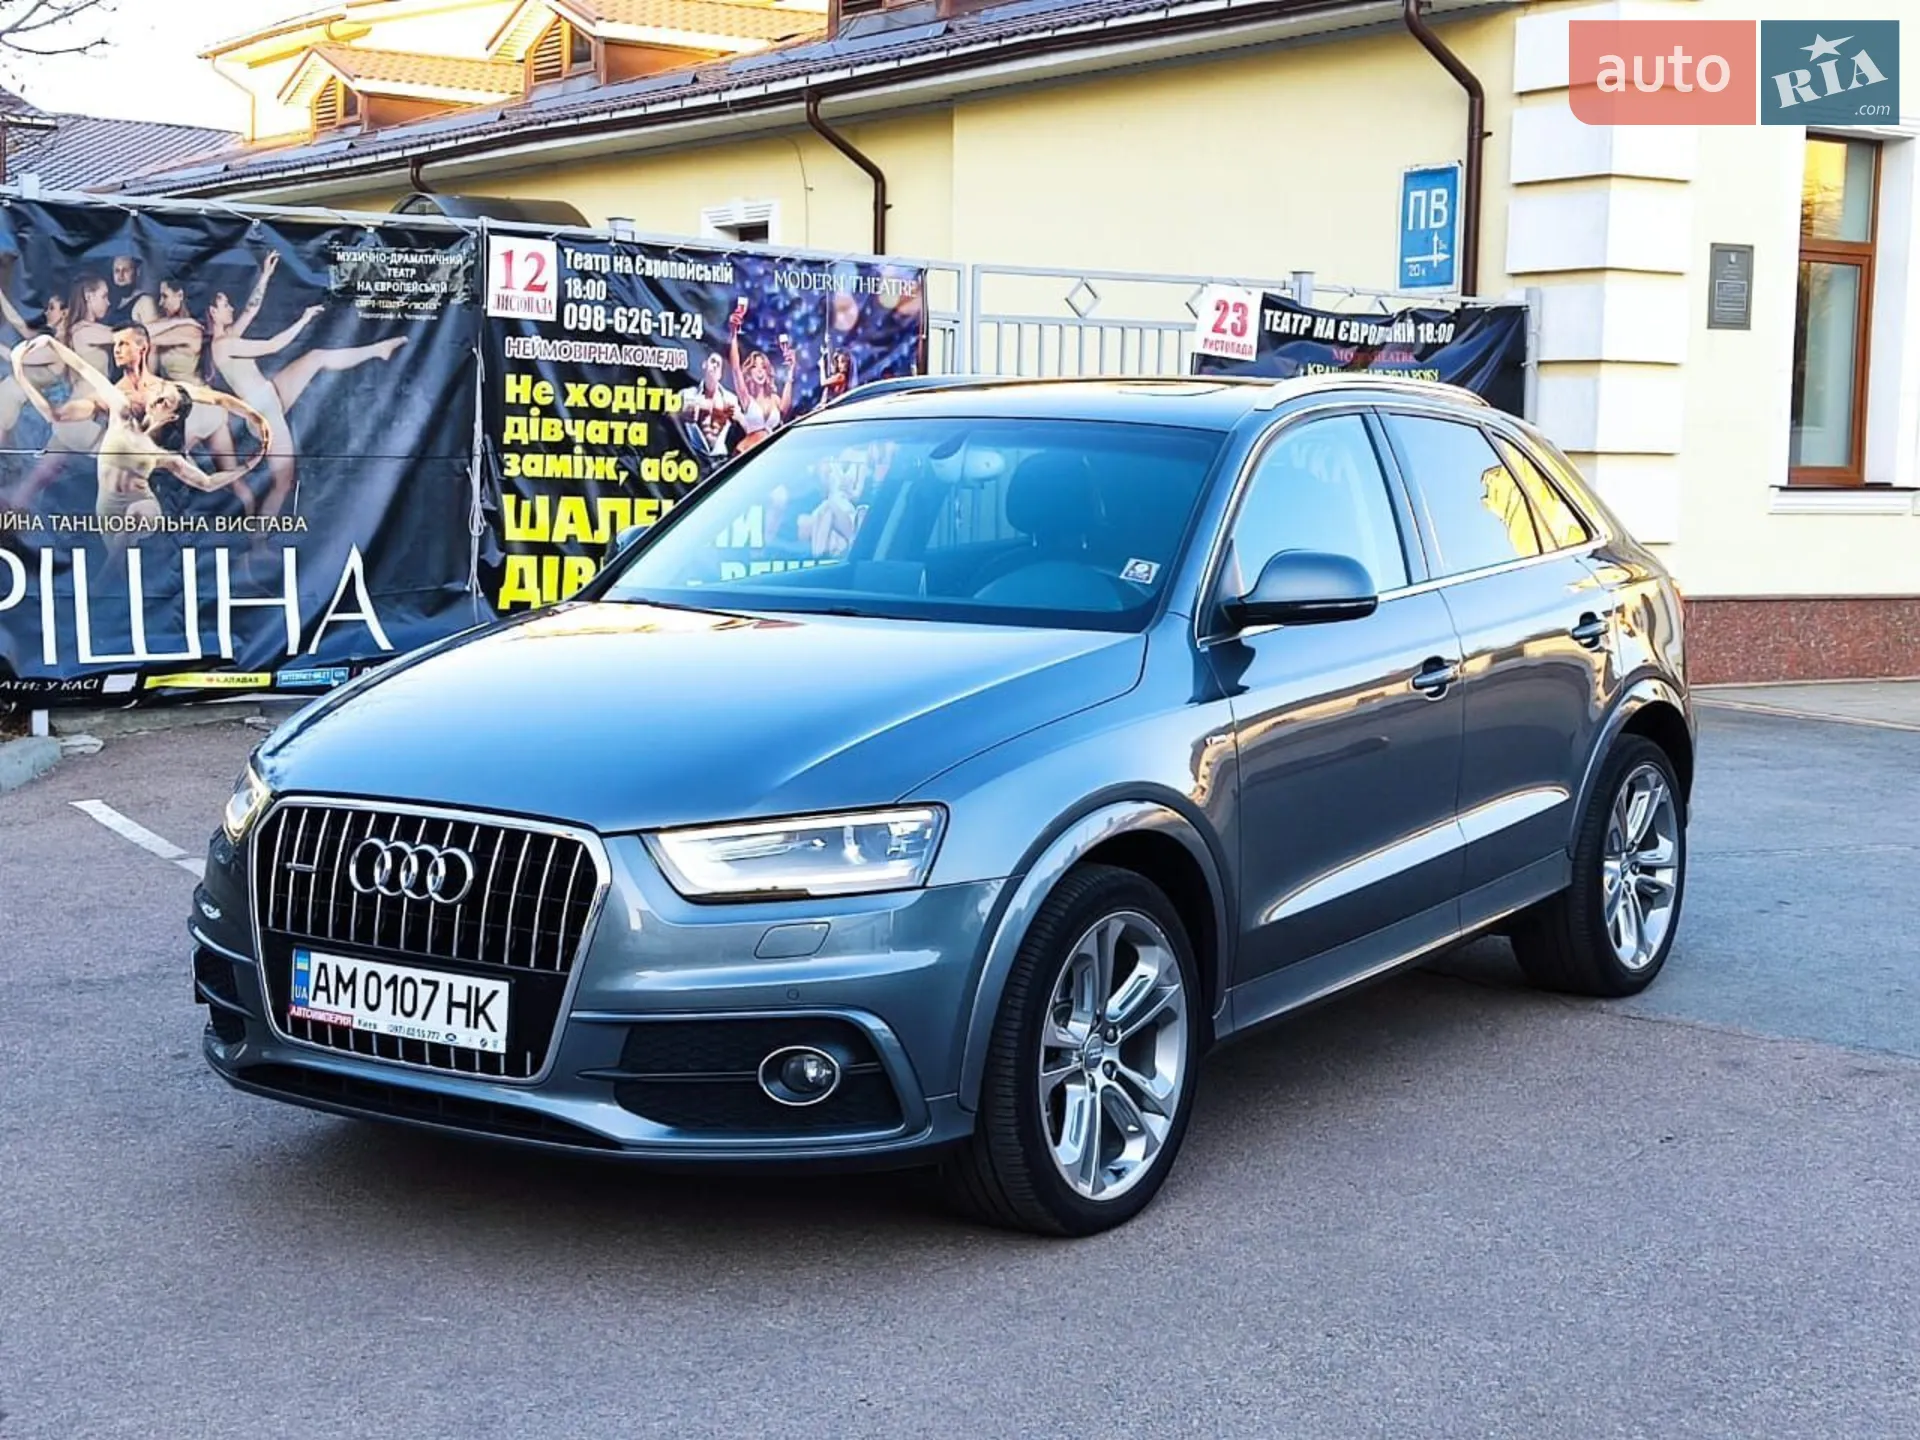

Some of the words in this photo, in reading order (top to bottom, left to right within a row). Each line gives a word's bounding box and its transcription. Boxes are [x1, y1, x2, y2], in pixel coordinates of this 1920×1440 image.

[1408, 188, 1449, 230] ПВ
[386, 267, 417, 278] ТЕАТР
[500, 249, 548, 293] 12
[564, 248, 611, 275] Театр
[613, 255, 635, 274] на
[635, 254, 734, 284] Європейській
[774, 270, 844, 292] MODERN
[851, 276, 917, 296] THEATRE
[356, 281, 372, 292] НА
[565, 278, 608, 302] 18:00
[493, 294, 553, 315] ЛИСТОПАДА
[563, 304, 704, 339] 098-626-11-24
[1212, 299, 1249, 337] 23
[1263, 309, 1311, 336] ТЕАТР
[1313, 318, 1336, 340] НА
[1417, 323, 1455, 343] 18:00
[505, 336, 620, 364] НЕЙМОВІРНА
[622, 345, 688, 368] КОМЕДІЯ
[1203, 337, 1253, 356] ЛИСТОПАДА
[505, 375, 554, 406] Не
[564, 378, 683, 414] ходіть
[503, 409, 649, 447] дівчата
[503, 447, 627, 486] заміж,
[640, 451, 699, 484] або
[48, 514, 209, 534] ТАНЦЮВАЛЬНА
[215, 514, 308, 533] ВИСТАВА
[295, 986, 308, 999] UA
[364, 970, 440, 1021] 0107
